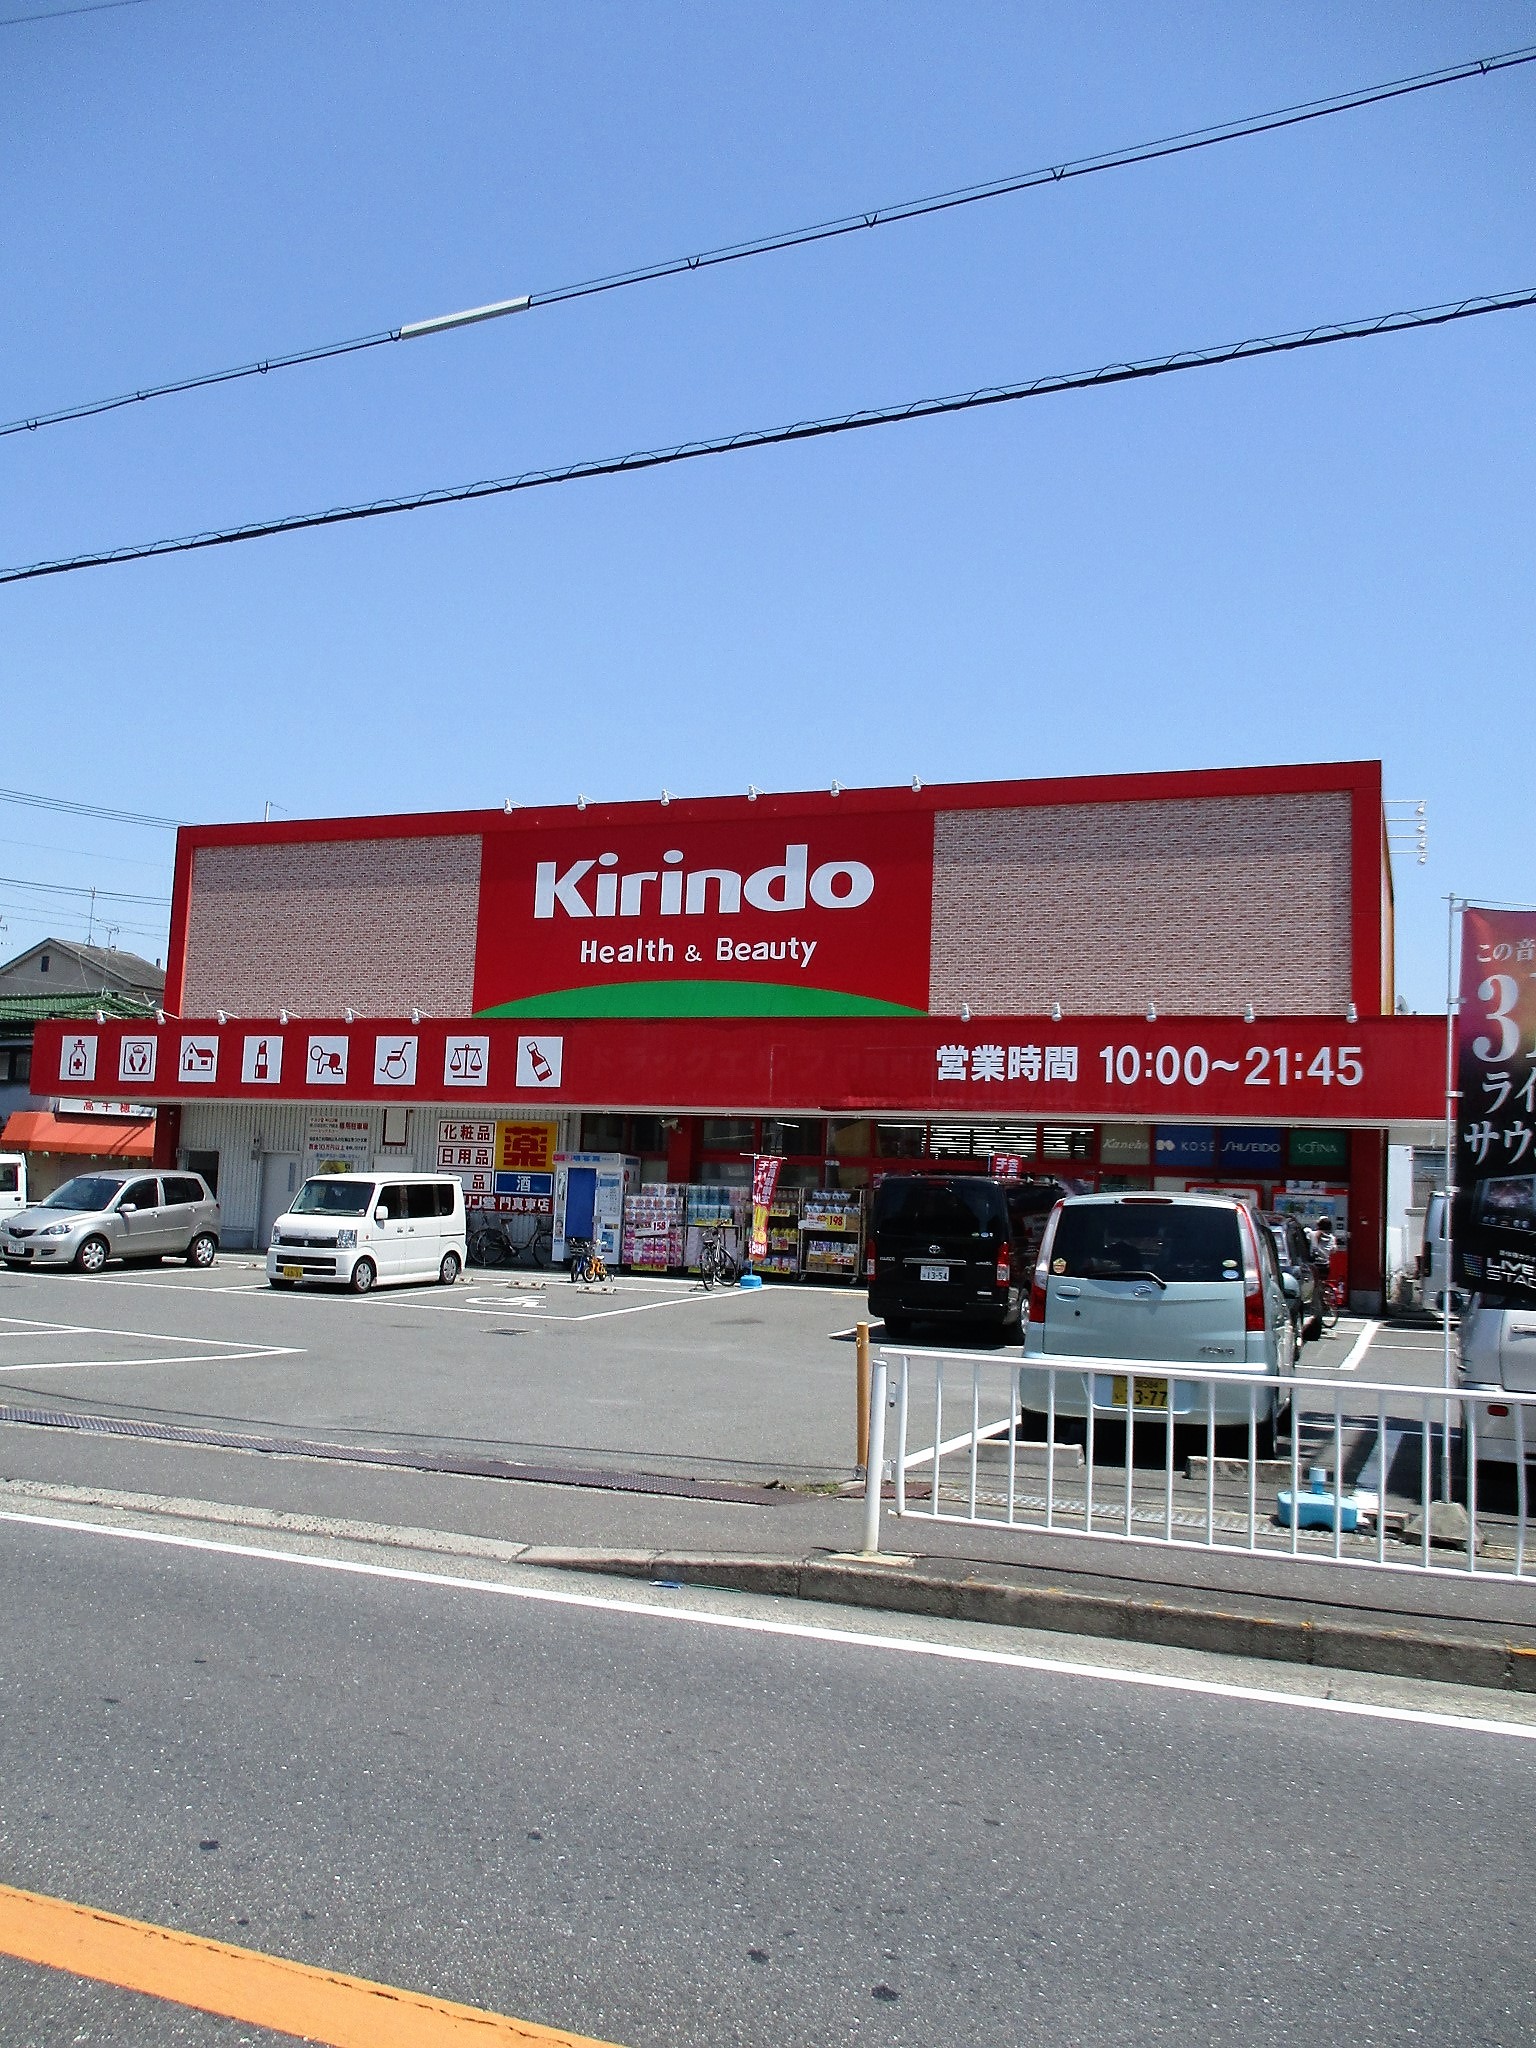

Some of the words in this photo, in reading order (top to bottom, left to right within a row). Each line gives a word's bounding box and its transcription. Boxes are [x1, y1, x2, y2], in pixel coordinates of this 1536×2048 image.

[534, 844, 875, 919] Kirindo
[580, 938, 674, 963] Health
[684, 944, 702, 963] &
[716, 937, 818, 968] Beauty
[936, 1044, 1079, 1083] 営業時間
[444, 1124, 490, 1141] 化粧品
[1221, 1141, 1281, 1153] SHISEIDO
[442, 1148, 489, 1165] 日用品
[516, 1176, 532, 1192] 酒
[499, 1197, 550, 1212] 門真東店
[653, 1221, 667, 1232] 158
[828, 1215, 843, 1226] 198
